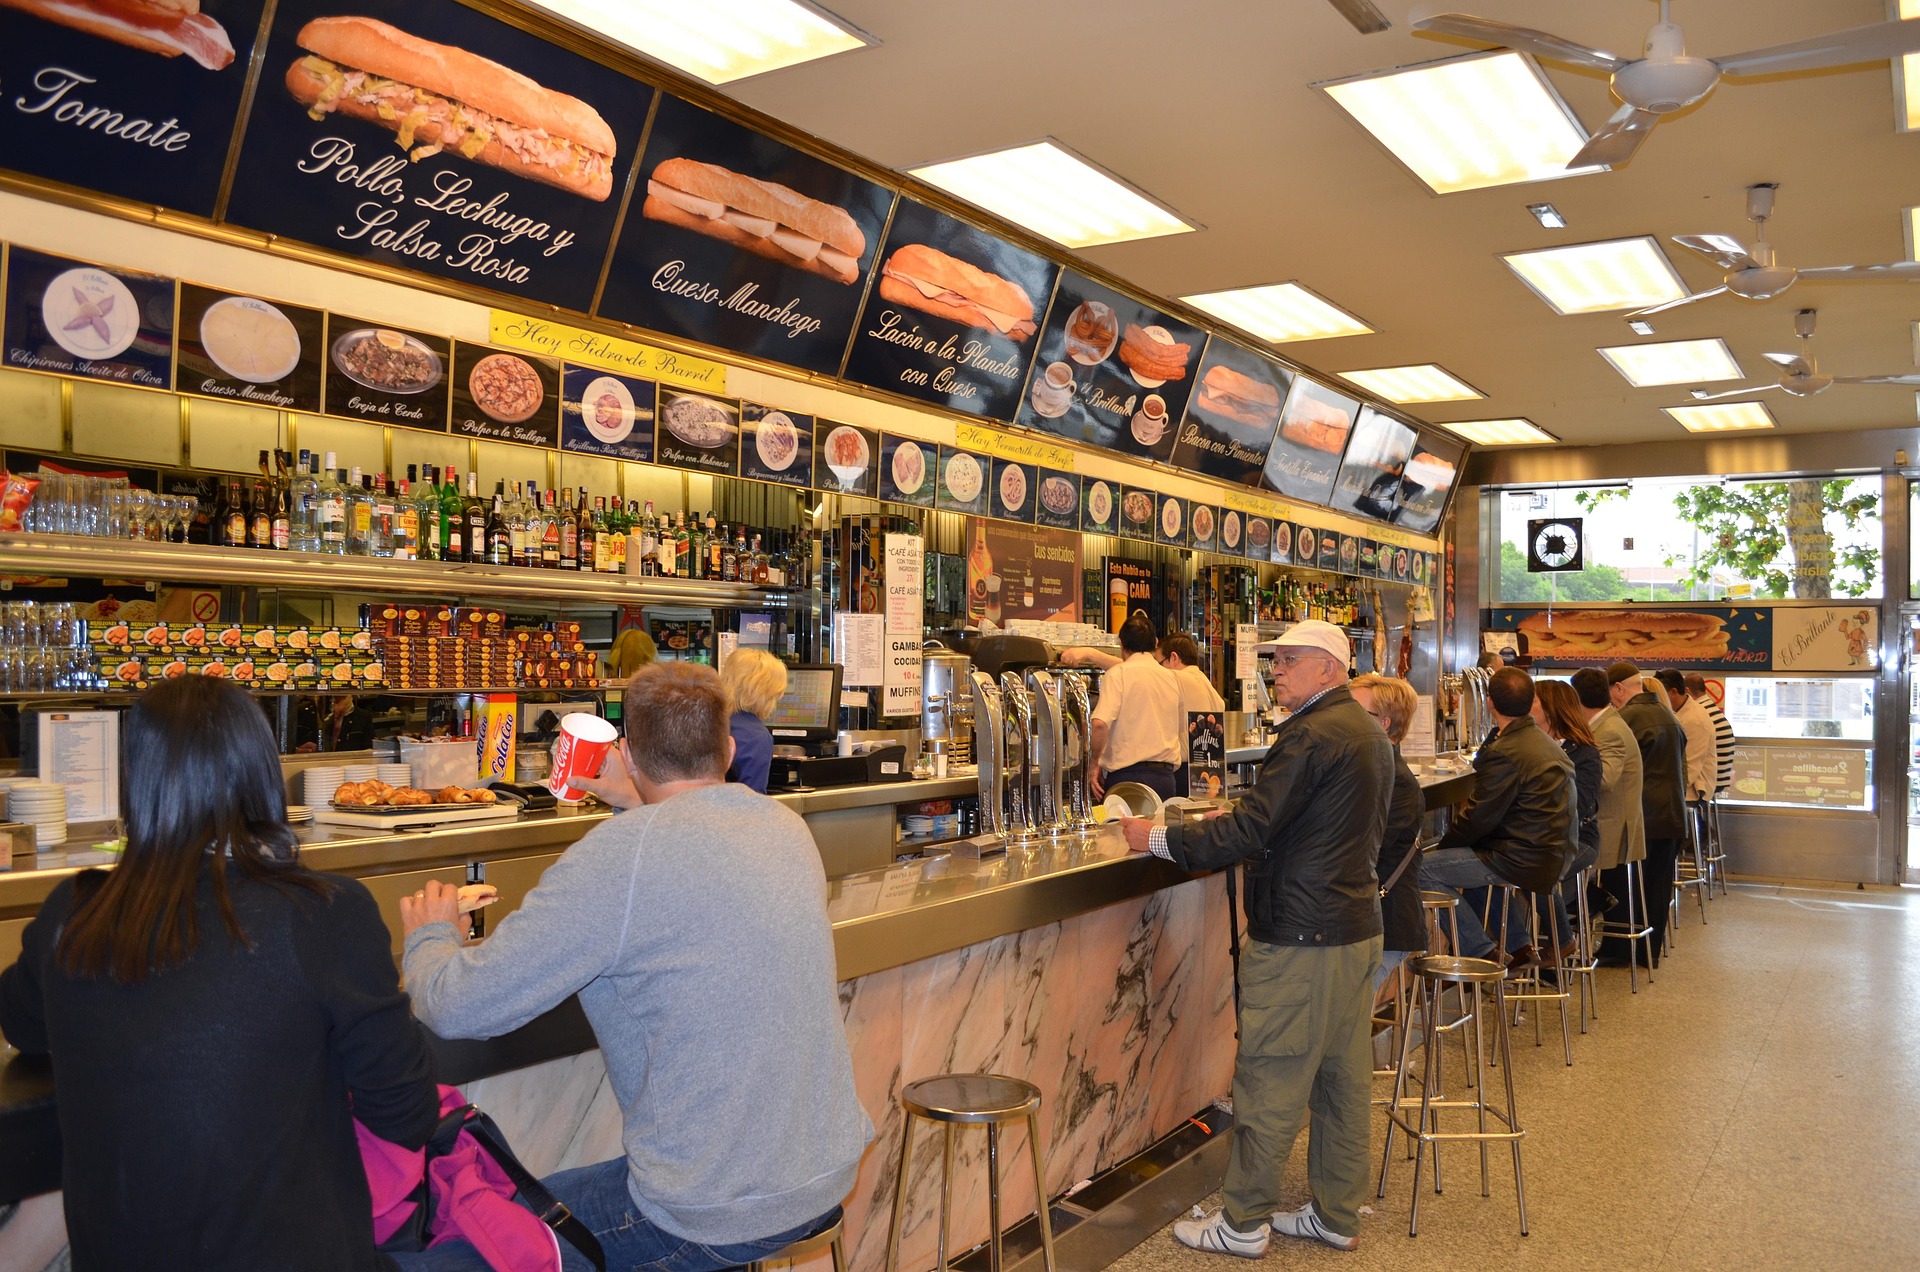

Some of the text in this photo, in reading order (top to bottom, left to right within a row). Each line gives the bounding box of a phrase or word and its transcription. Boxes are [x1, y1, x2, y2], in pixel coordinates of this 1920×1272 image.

[15, 67, 193, 153] Tomate
[297, 136, 576, 256] Pollo, Lechuga y
[337, 202, 530, 285] Salsa Rosa
[651, 260, 821, 338] Queso Manchego
[505, 320, 715, 383] Hay Sidra de Barril
[868, 310, 1020, 381] Lacón a la Plancha
[10, 348, 163, 385] Chipirones Aceite de Oliva
[200, 379, 295, 407] Queso Manchego
[900, 365, 978, 400] con Queso
[347, 396, 424, 420] Oreja de Cerdo
[461, 419, 548, 444] Pulpo a la Gallega
[661, 448, 684, 462] Pulpo
[684, 453, 697, 464] con
[957, 427, 990, 450] Hay
[1034, 447, 1044, 459] de
[1047, 449, 1071, 469] Grifo
[1181, 423, 1266, 466] Bacon con Pimientos
[1034, 542, 1075, 563] tus sentidos
[1109, 562, 1122, 575] Esta
[1122, 563, 1139, 577] Rubia
[1145, 569, 1151, 577] la
[890, 586, 905, 595] CAFÉ
[1129, 580, 1151, 599] CAÑA
[892, 641, 921, 652] GAMBAS
[1778, 609, 1838, 667] El Brillante
[893, 657, 921, 666] COCIDAS
[1553, 649, 1610, 662] BOCADILLO
[1721, 649, 1769, 664] MADRID
[903, 671, 911, 680] 10
[890, 686, 921, 698] MUFFINS
[1193, 728, 1220, 751] muffins
